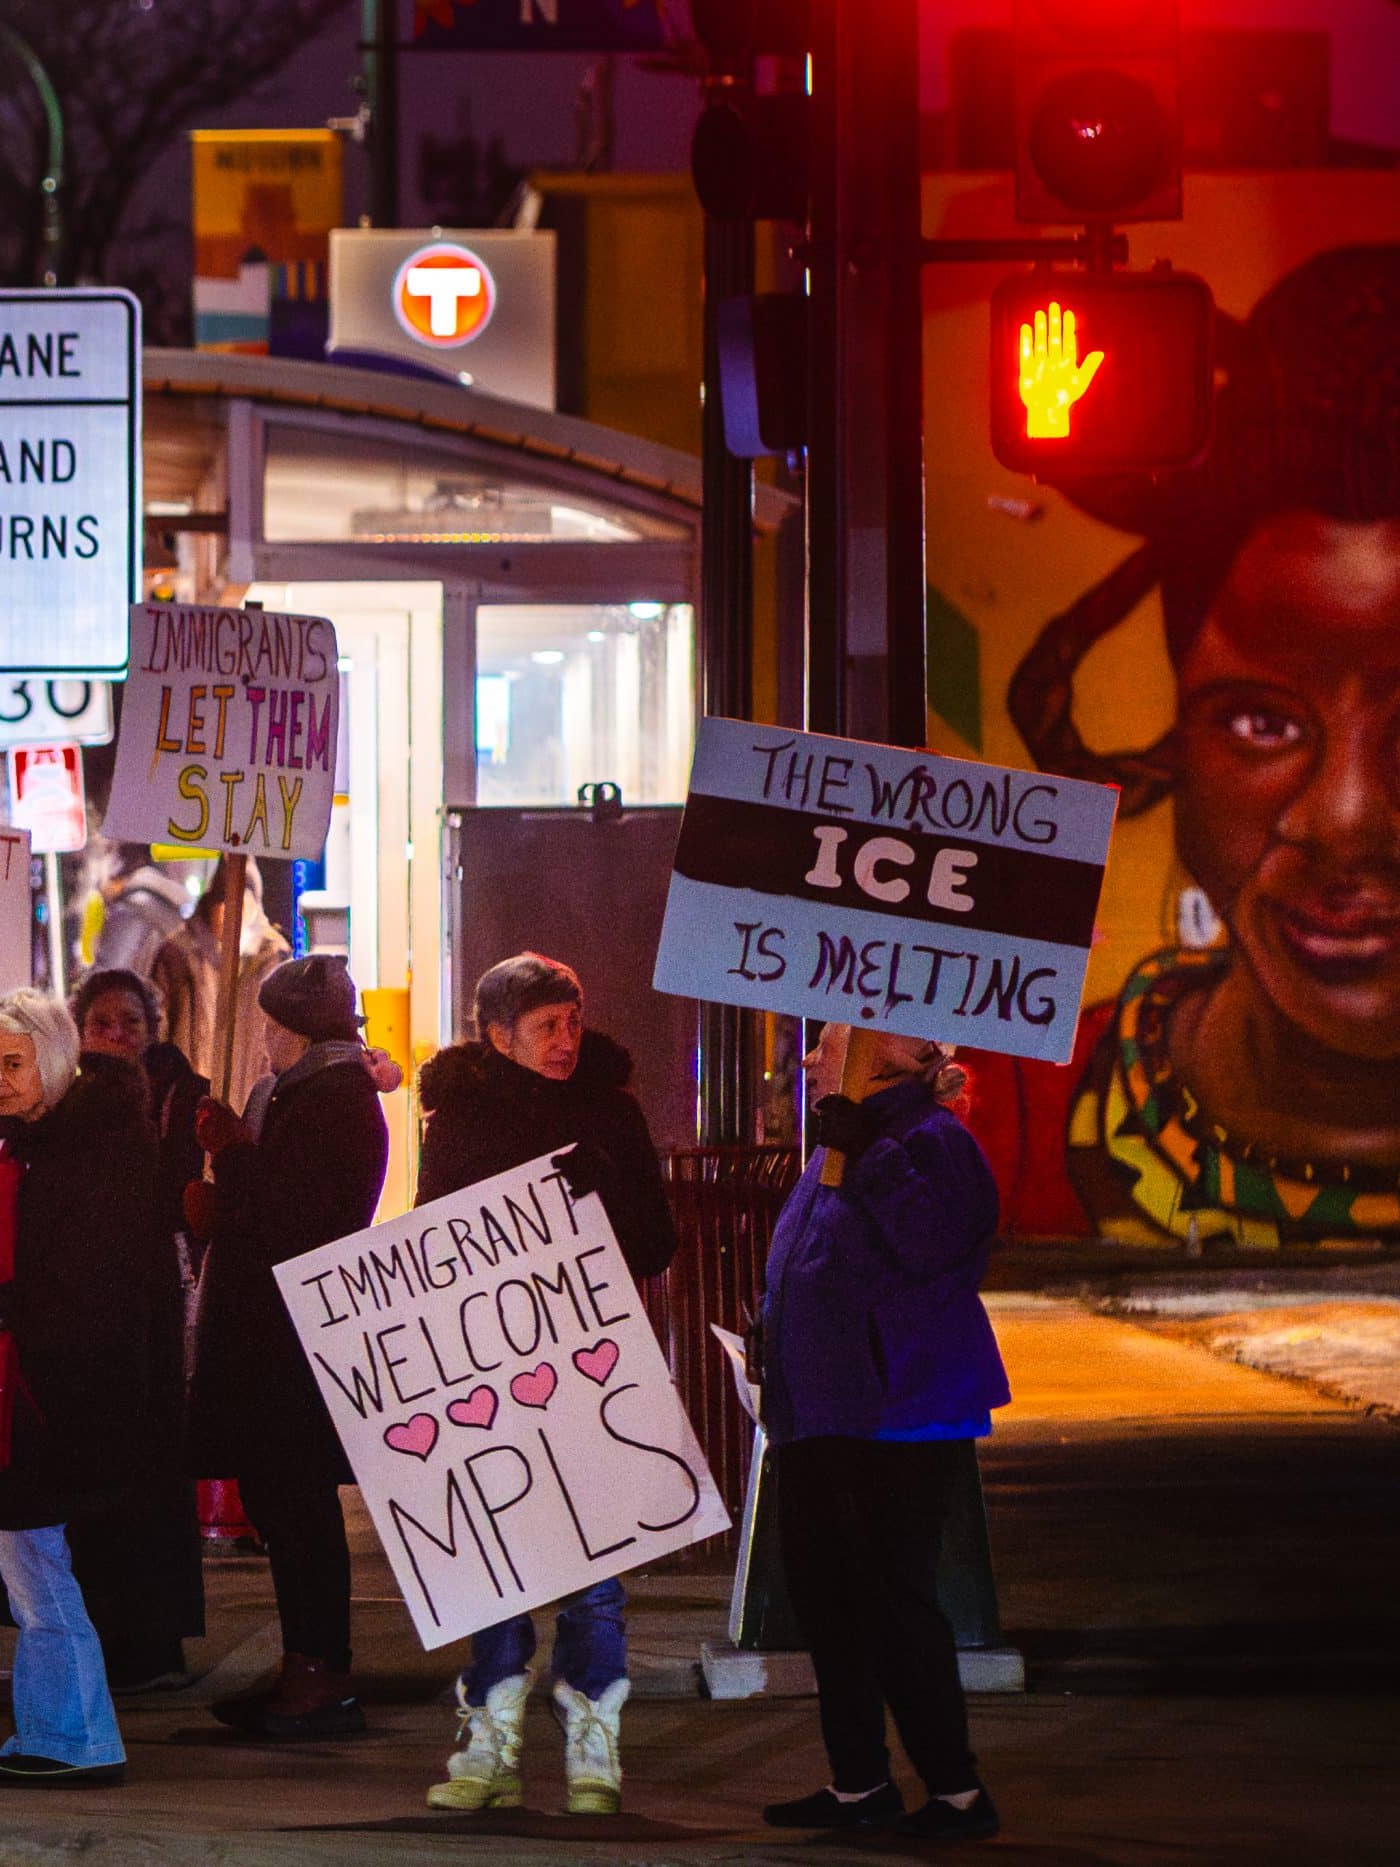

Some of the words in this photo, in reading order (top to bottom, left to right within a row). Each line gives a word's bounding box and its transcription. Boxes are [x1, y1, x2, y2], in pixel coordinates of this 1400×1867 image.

[407, 267, 480, 336] T
[141, 608, 328, 684] IMMIGRANTS
[155, 684, 235, 760] LET
[246, 686, 332, 772] THEM
[167, 763, 304, 850] STAY
[752, 738, 855, 813] THE
[865, 764, 1059, 845] WRONG
[804, 825, 979, 912] ICE
[727, 921, 786, 982] IS
[807, 930, 1058, 1026] MELTING
[301, 1171, 579, 1329] IMMIGRANT
[313, 1245, 631, 1420] WELCOME
[387, 1383, 701, 1627] MPLS
